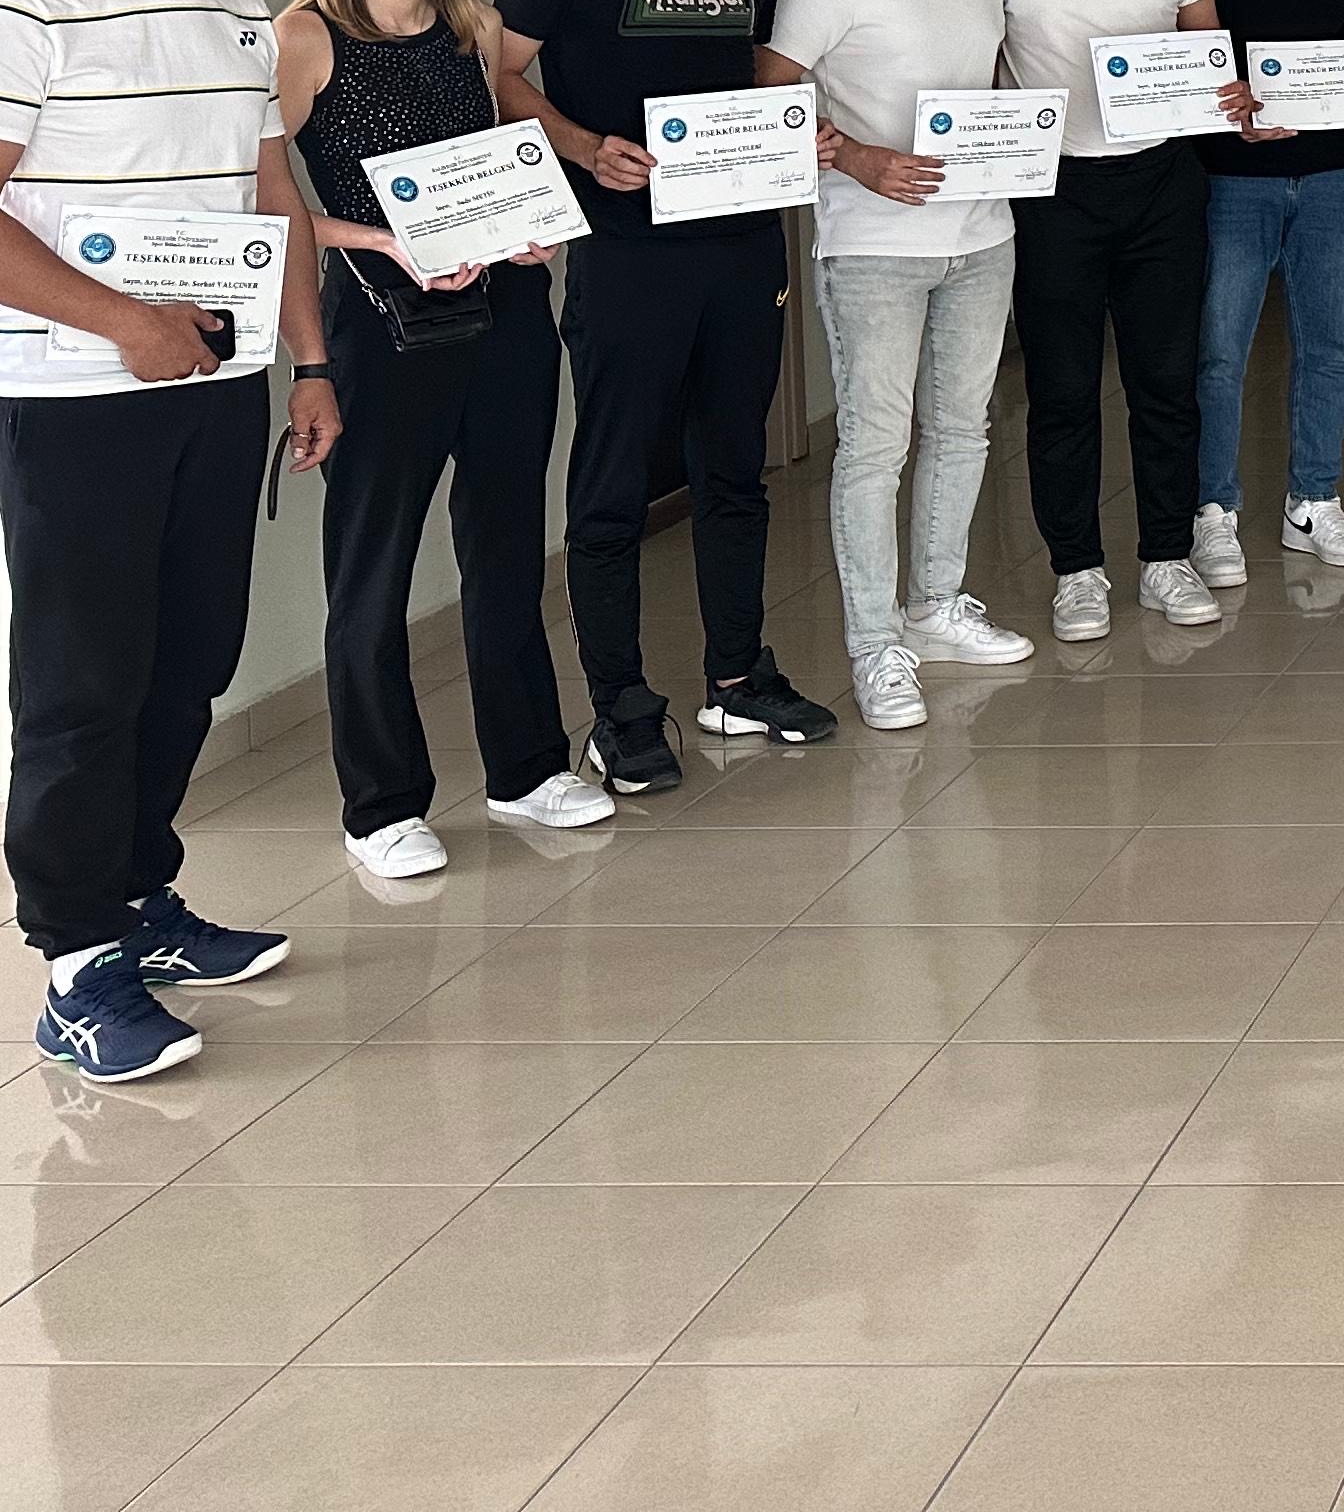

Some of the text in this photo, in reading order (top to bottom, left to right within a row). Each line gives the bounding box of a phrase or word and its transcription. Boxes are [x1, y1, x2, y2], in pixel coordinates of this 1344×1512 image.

[477, 161, 516, 180] BELGESİ
[124, 253, 235, 266] TEŞEKKÜR BELGESİ
